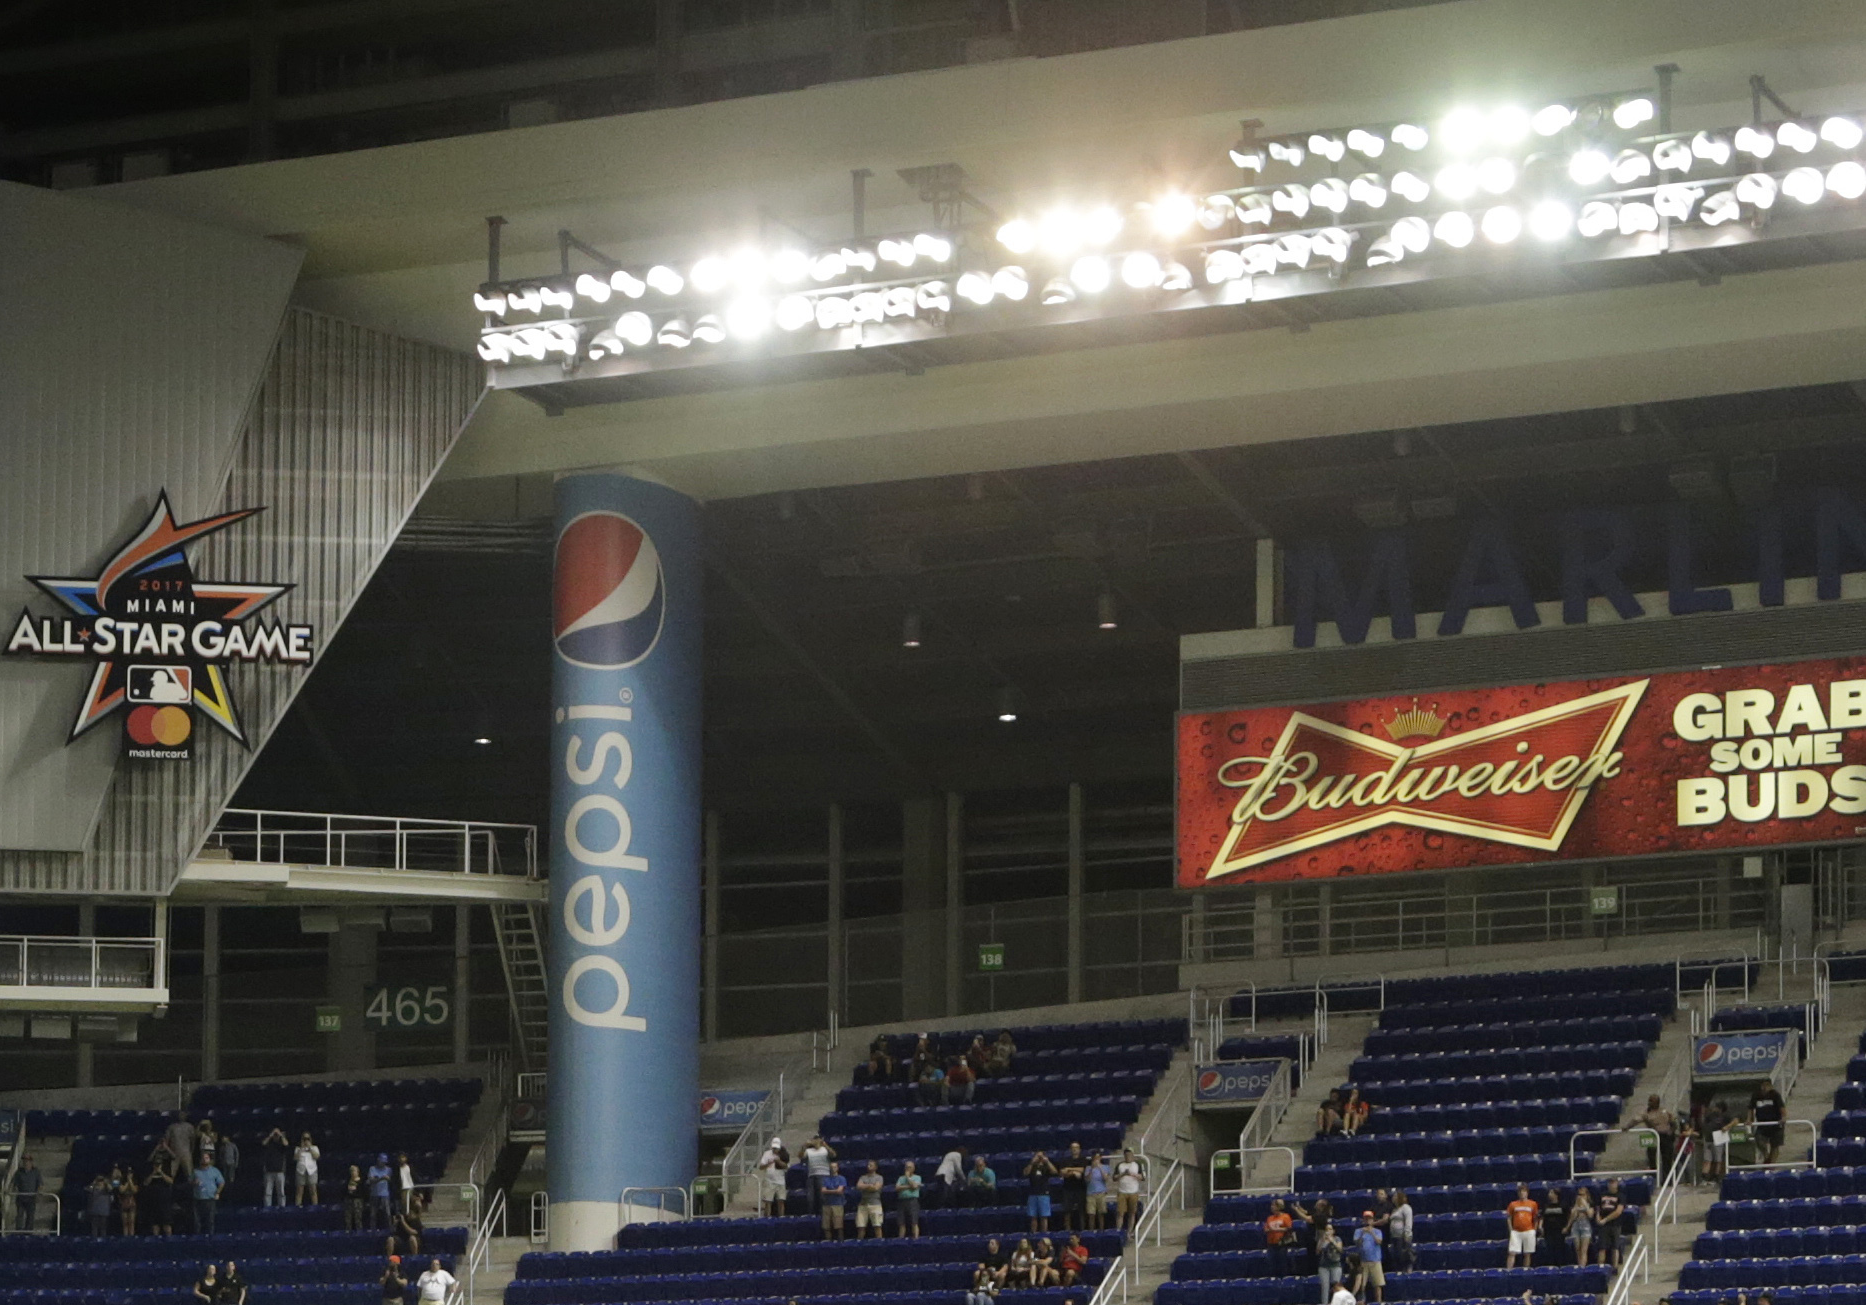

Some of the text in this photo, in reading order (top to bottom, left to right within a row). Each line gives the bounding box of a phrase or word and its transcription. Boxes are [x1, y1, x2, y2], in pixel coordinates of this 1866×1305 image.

[139, 579, 183, 592] 2017
[126, 598, 195, 615] MIAMI
[7, 614, 312, 660] ALL STAR GAME
[1671, 677, 1866, 743] GRAB
[128, 748, 189, 760] mastercard
[1709, 732, 1844, 773] SOME
[1217, 740, 1624, 827] Budweiser
[1676, 766, 1866, 829] BUDS
[555, 706, 649, 1032] pepsi
[981, 953, 1003, 966] 138
[318, 1015, 340, 1027] 137
[365, 985, 450, 1027] 465
[1726, 1042, 1783, 1065] pepsi
